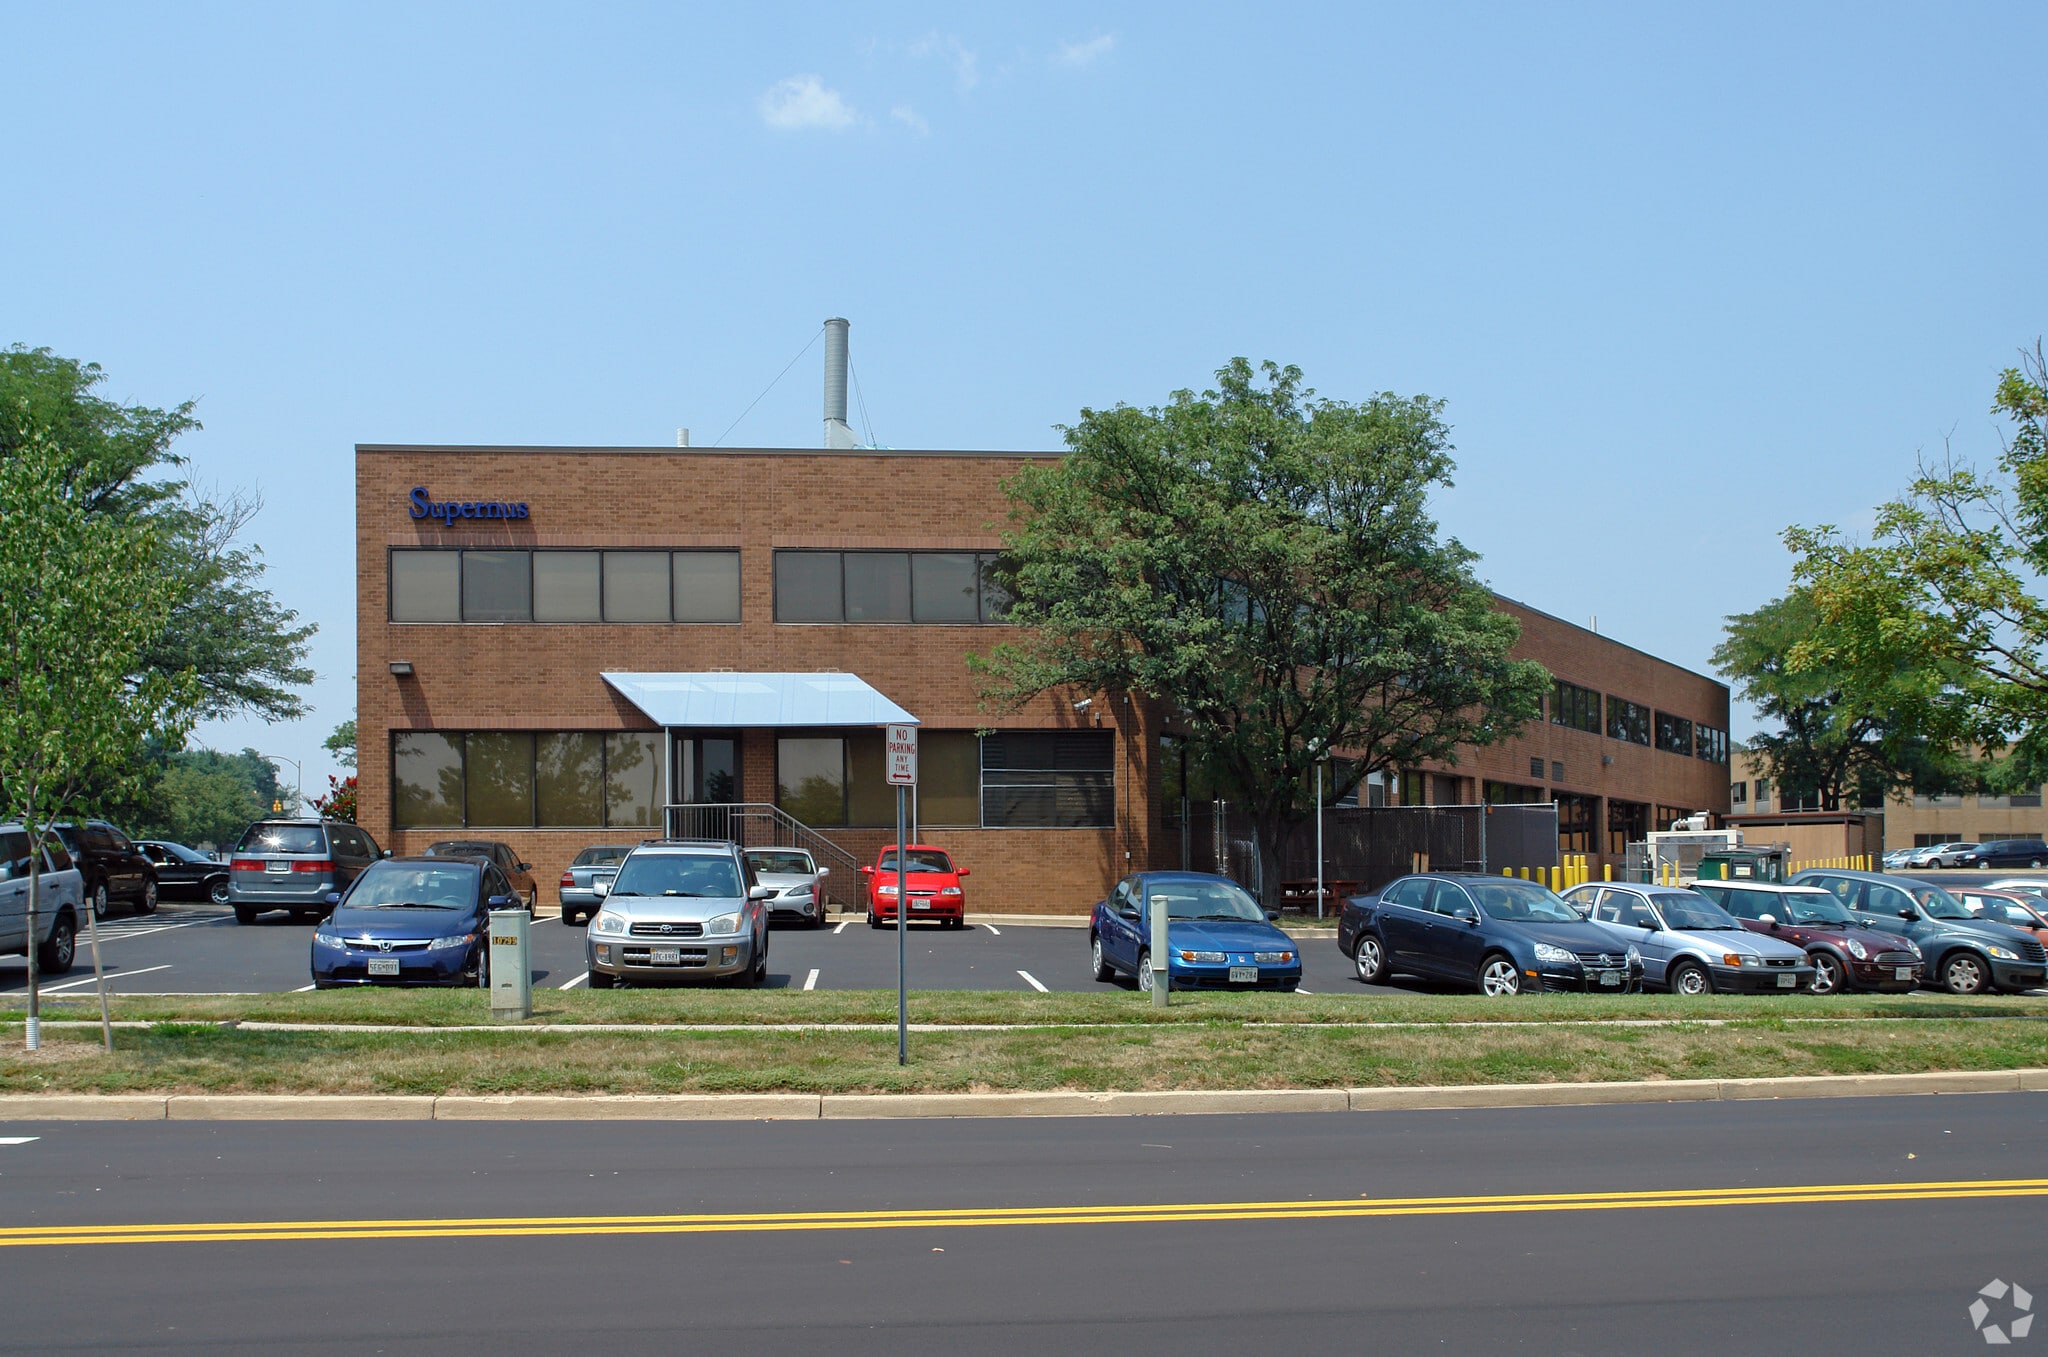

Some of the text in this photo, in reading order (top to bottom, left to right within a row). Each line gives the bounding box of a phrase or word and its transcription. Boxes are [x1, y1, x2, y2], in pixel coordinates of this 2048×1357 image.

[408, 486, 529, 526] Supernus
[896, 729, 908, 741] NO
[889, 742, 915, 755] PARKING
[896, 755, 908, 763] ANY
[895, 764, 910, 772] TIME
